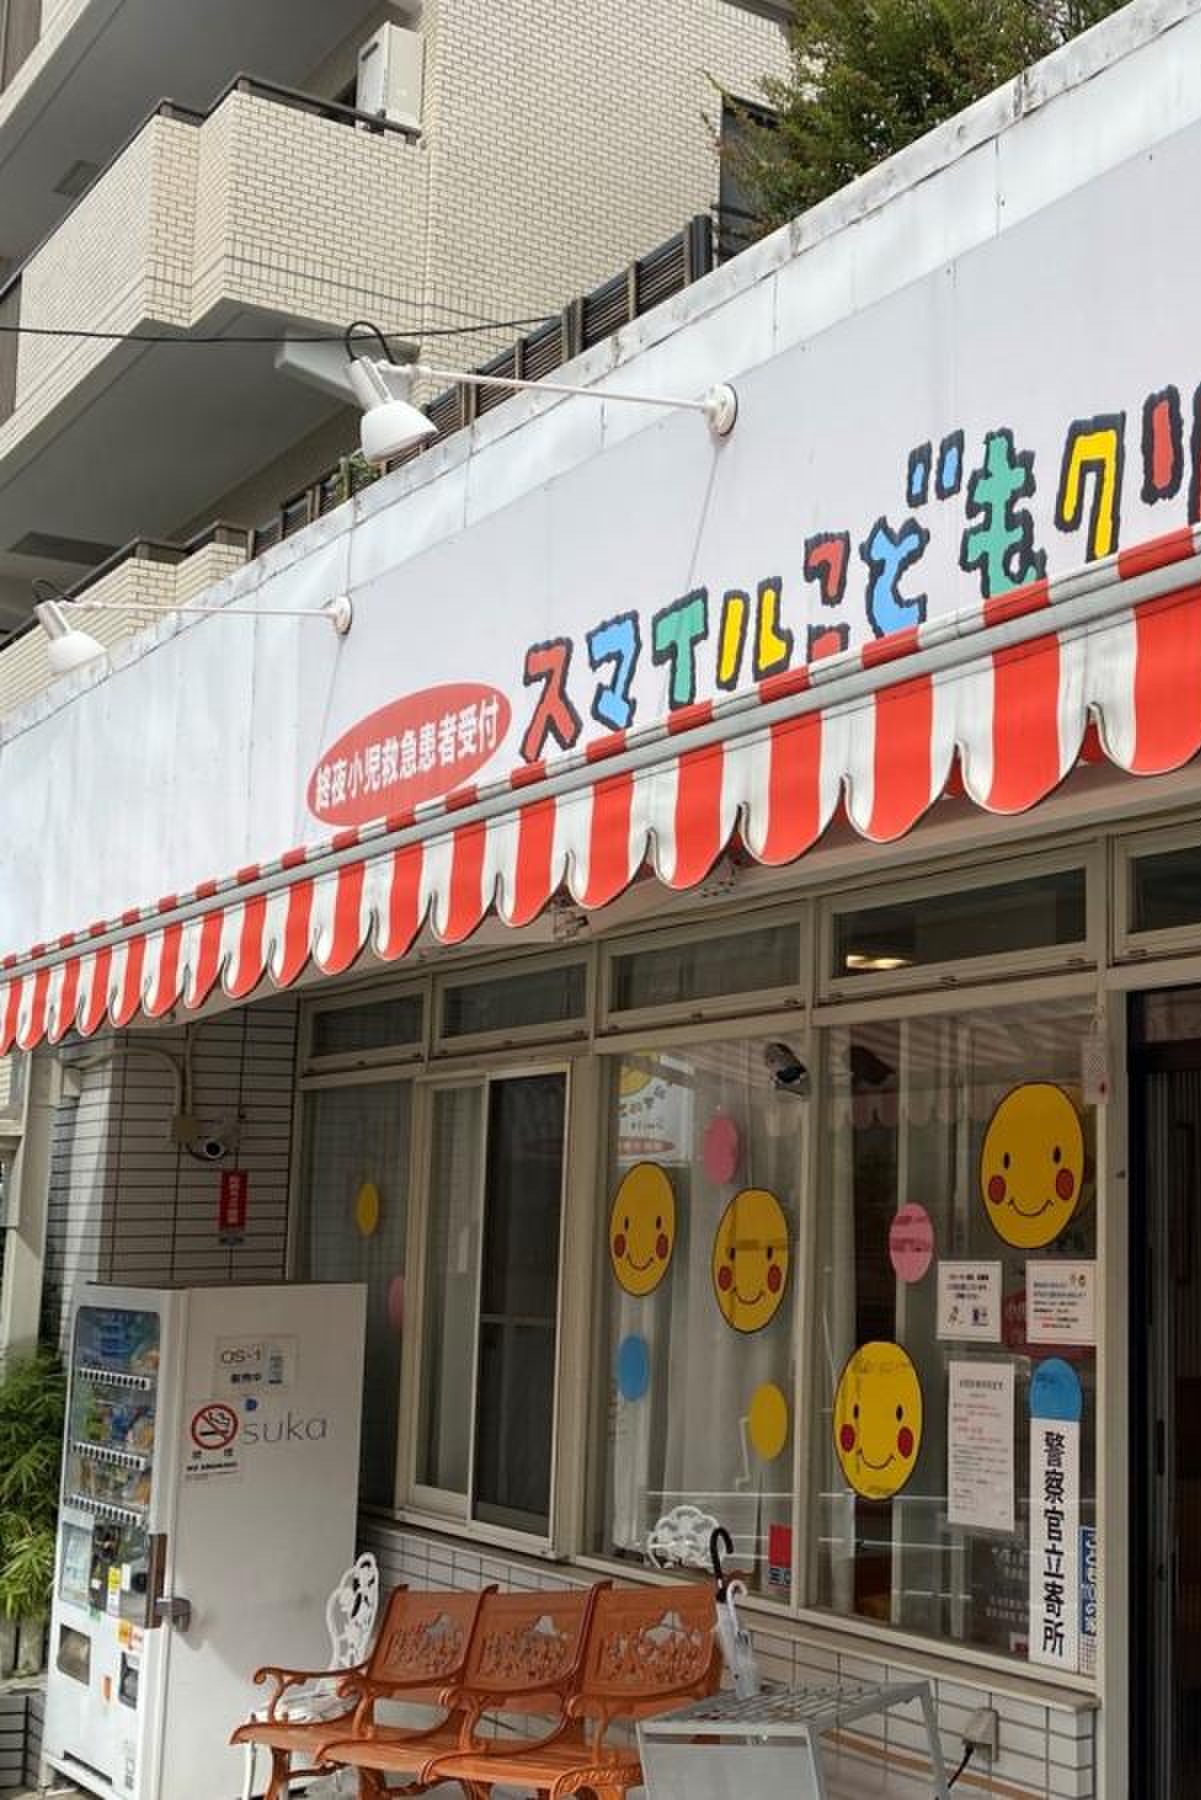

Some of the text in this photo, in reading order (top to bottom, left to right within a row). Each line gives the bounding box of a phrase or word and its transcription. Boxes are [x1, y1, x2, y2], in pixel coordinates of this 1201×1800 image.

[1041, 1430, 1066, 1658] 警察官立寄所
